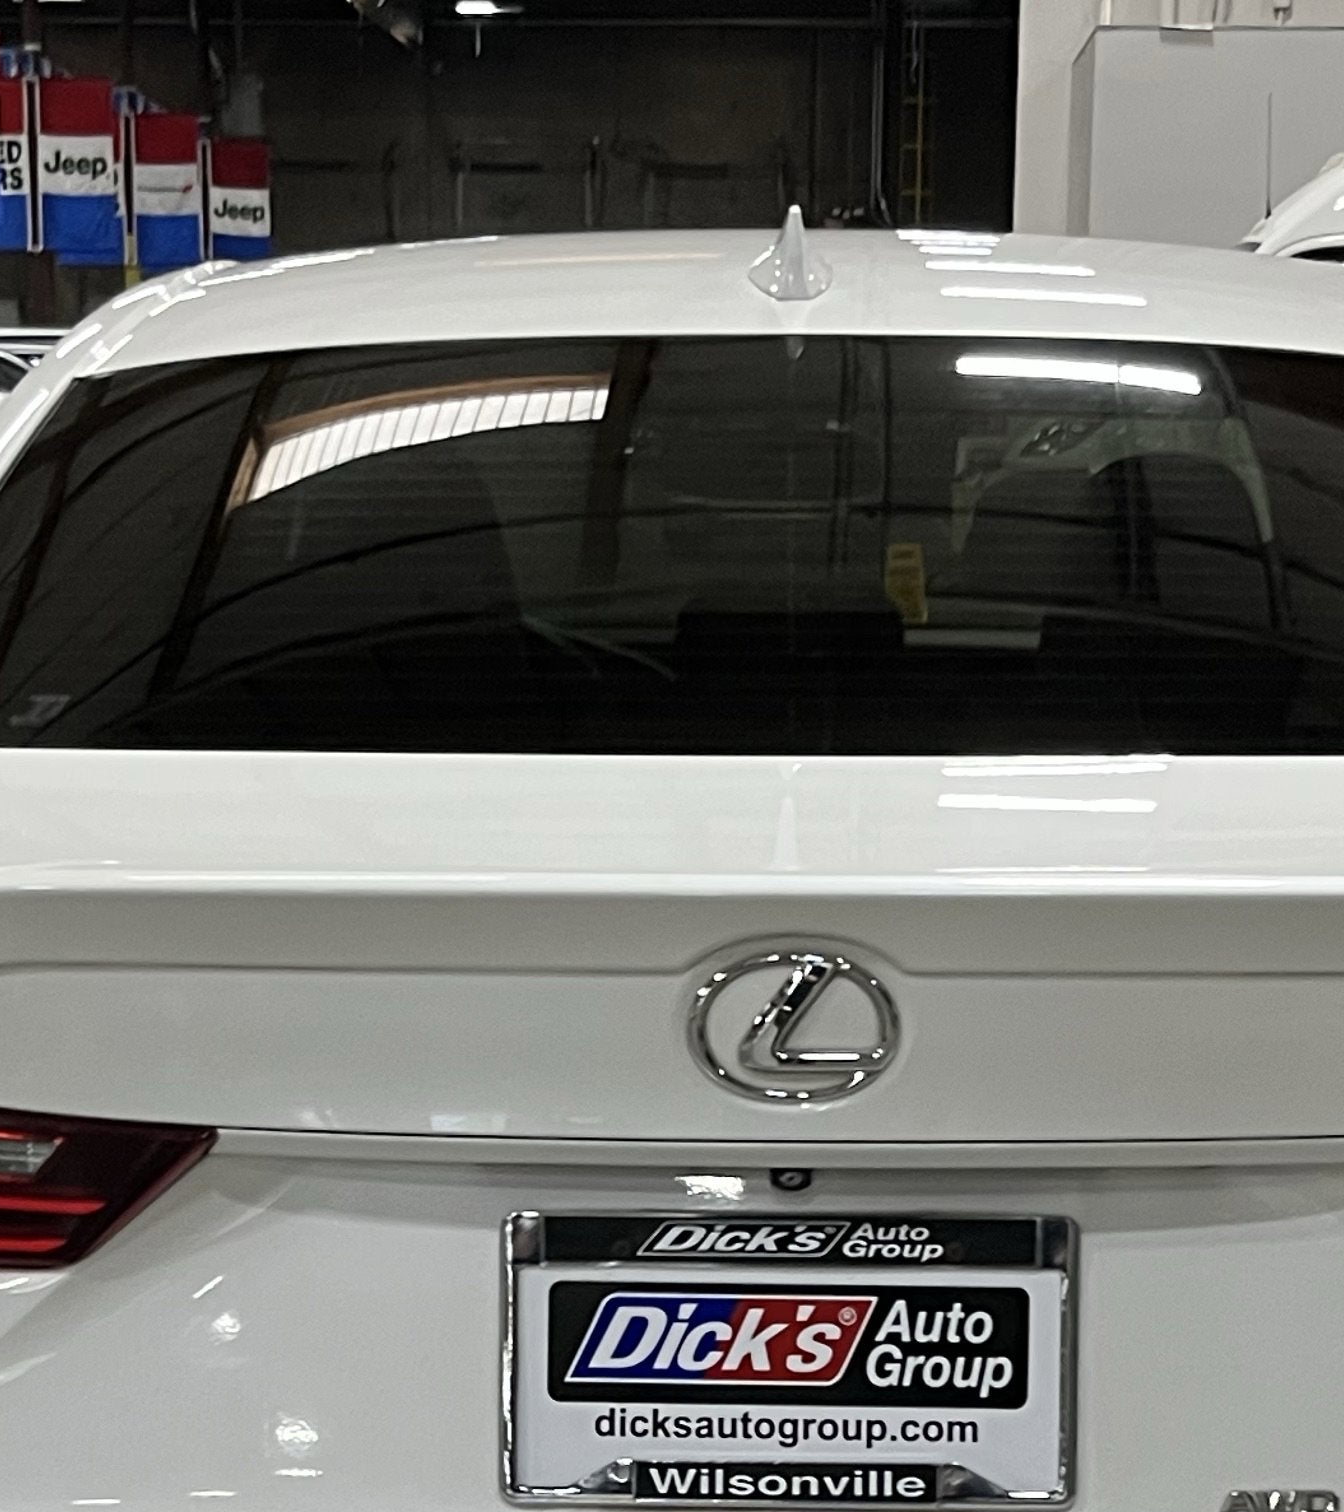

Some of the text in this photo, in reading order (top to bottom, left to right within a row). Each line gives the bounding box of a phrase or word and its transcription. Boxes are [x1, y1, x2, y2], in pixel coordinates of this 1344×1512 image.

[44, 150, 108, 180] Jeep
[214, 198, 265, 224] Jeep
[653, 1224, 827, 1252] Dick's
[849, 1222, 931, 1241] Auto
[842, 1239, 945, 1262] Group
[875, 1299, 994, 1344] Auto
[587, 1302, 843, 1373] Dick's
[866, 1343, 1014, 1399] Group
[595, 1408, 979, 1448] dicksautogroup.com
[649, 1466, 927, 1498] Wilsonville
